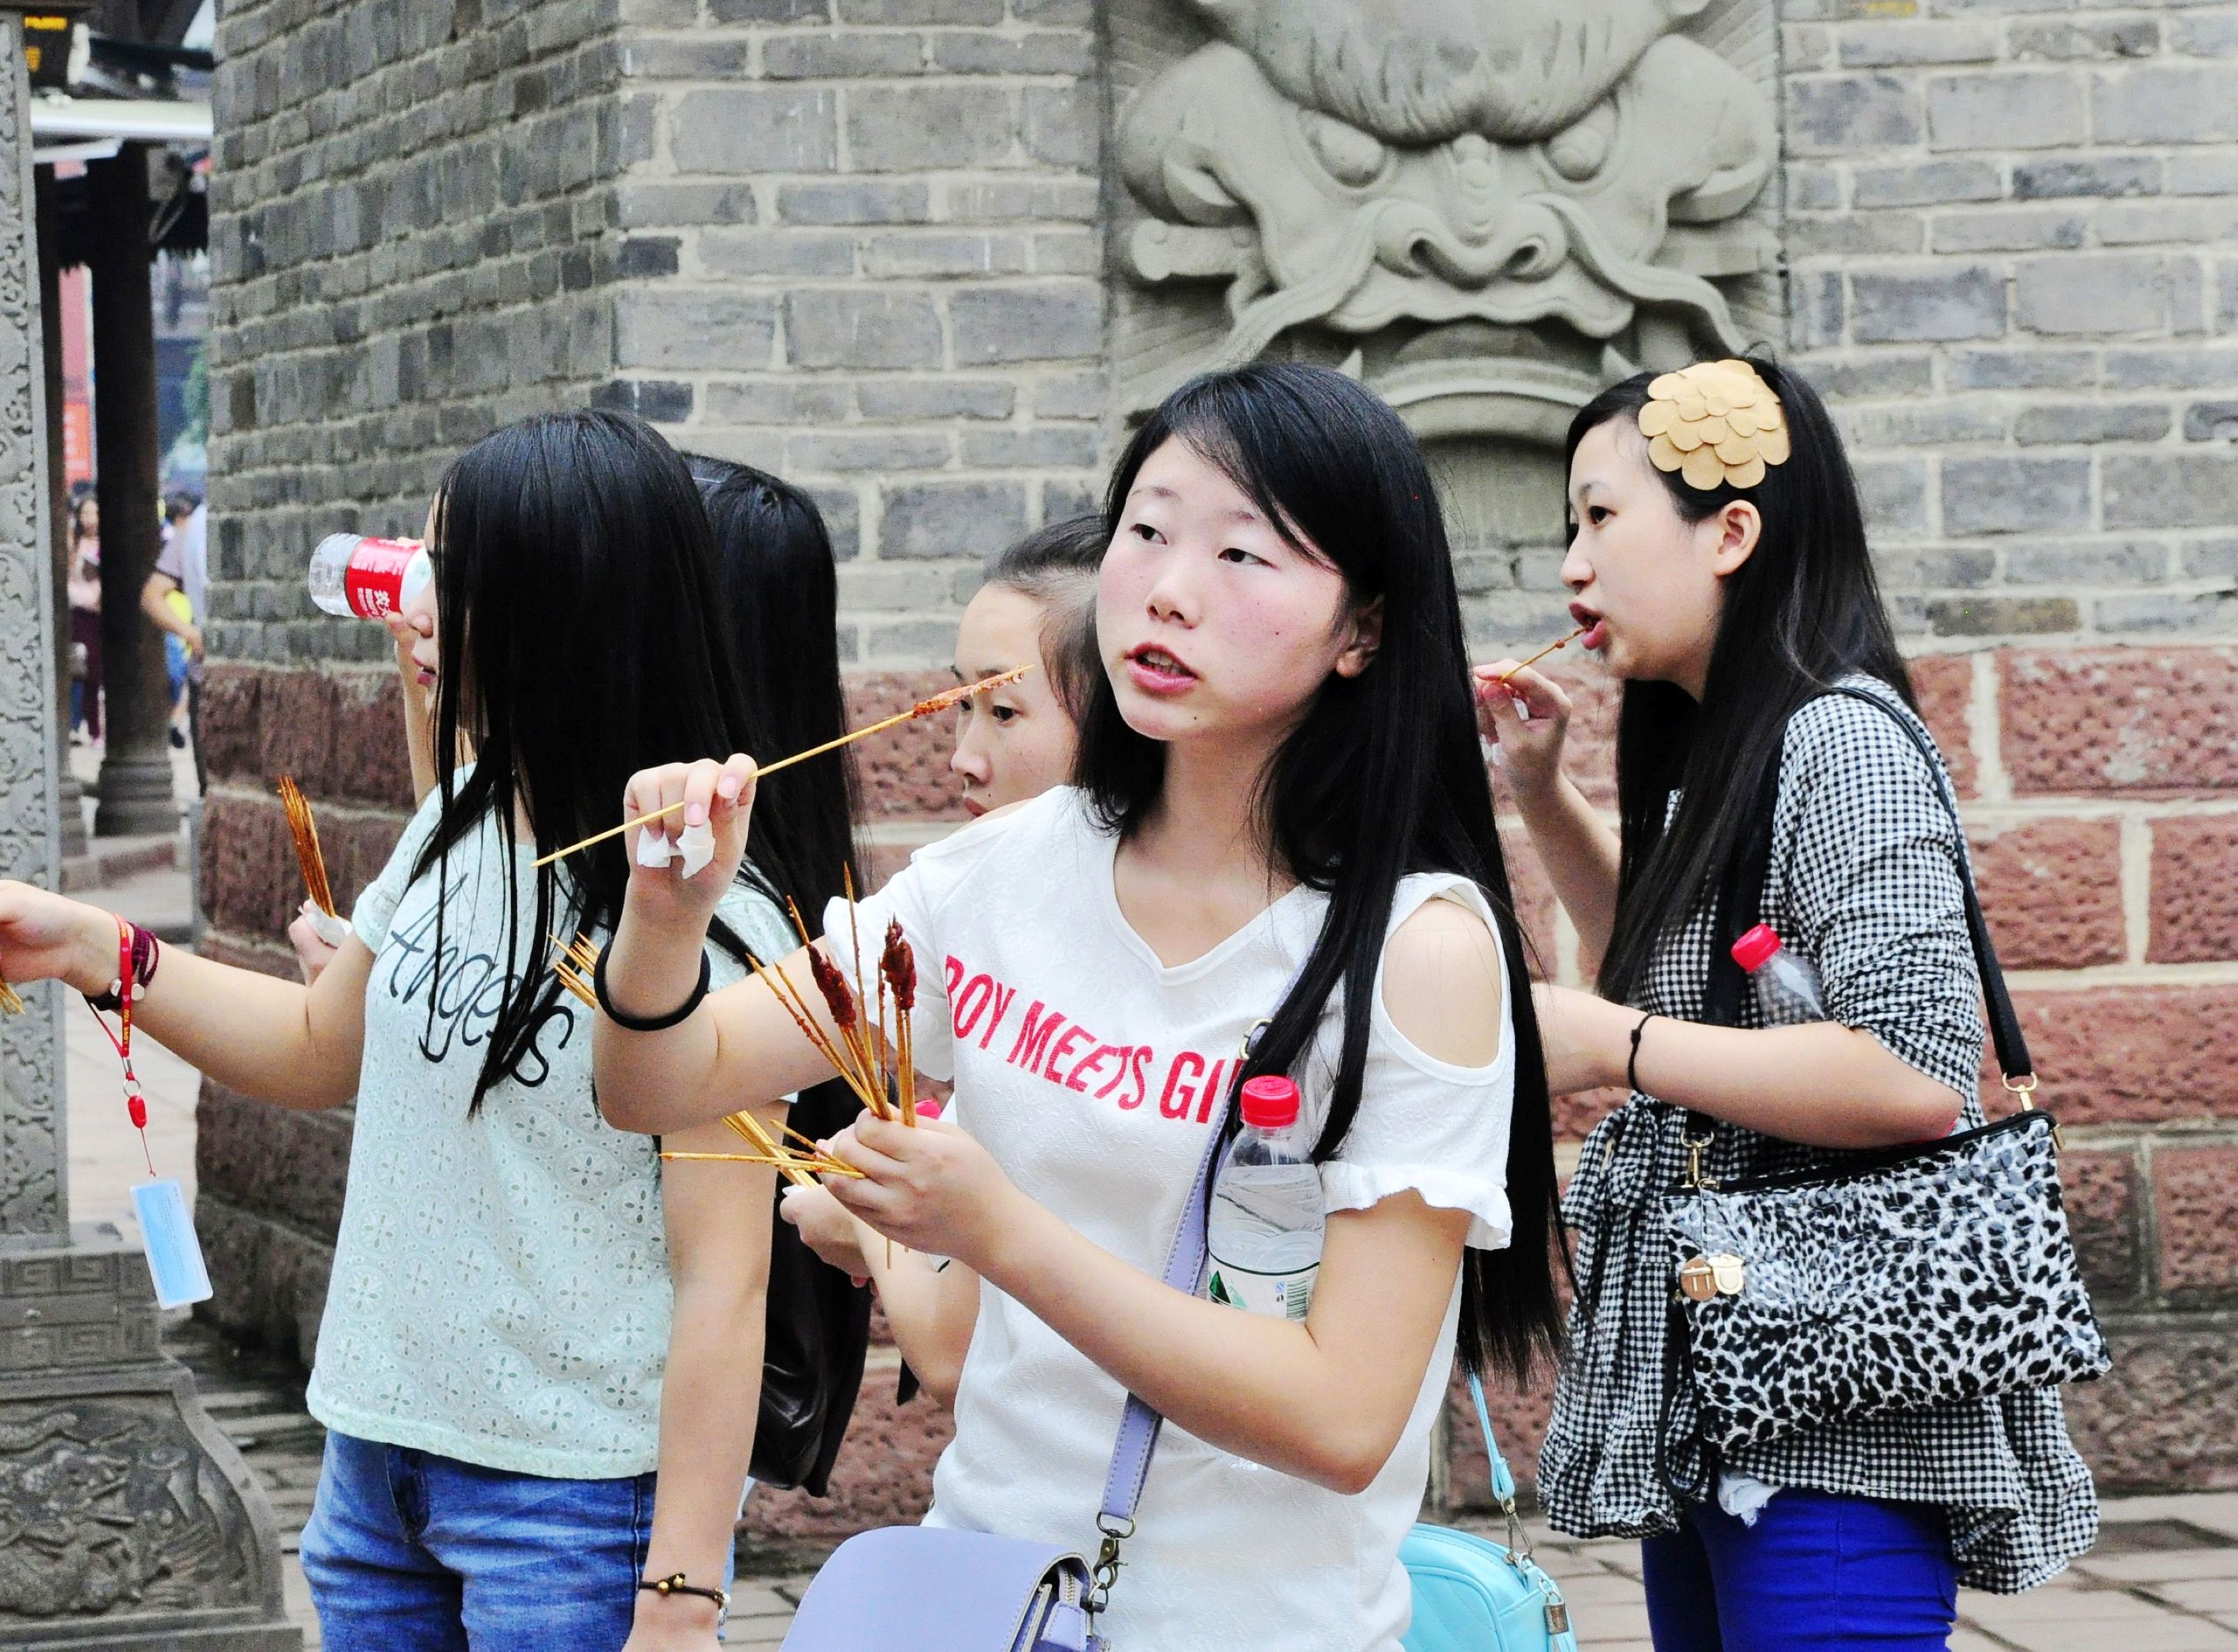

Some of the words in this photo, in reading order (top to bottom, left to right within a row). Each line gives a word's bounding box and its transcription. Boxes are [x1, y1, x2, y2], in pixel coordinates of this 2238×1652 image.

[377, 873, 575, 1087] Anges
[1006, 1001, 1153, 1111] MEETS
[1159, 1051, 1244, 1124] GI
